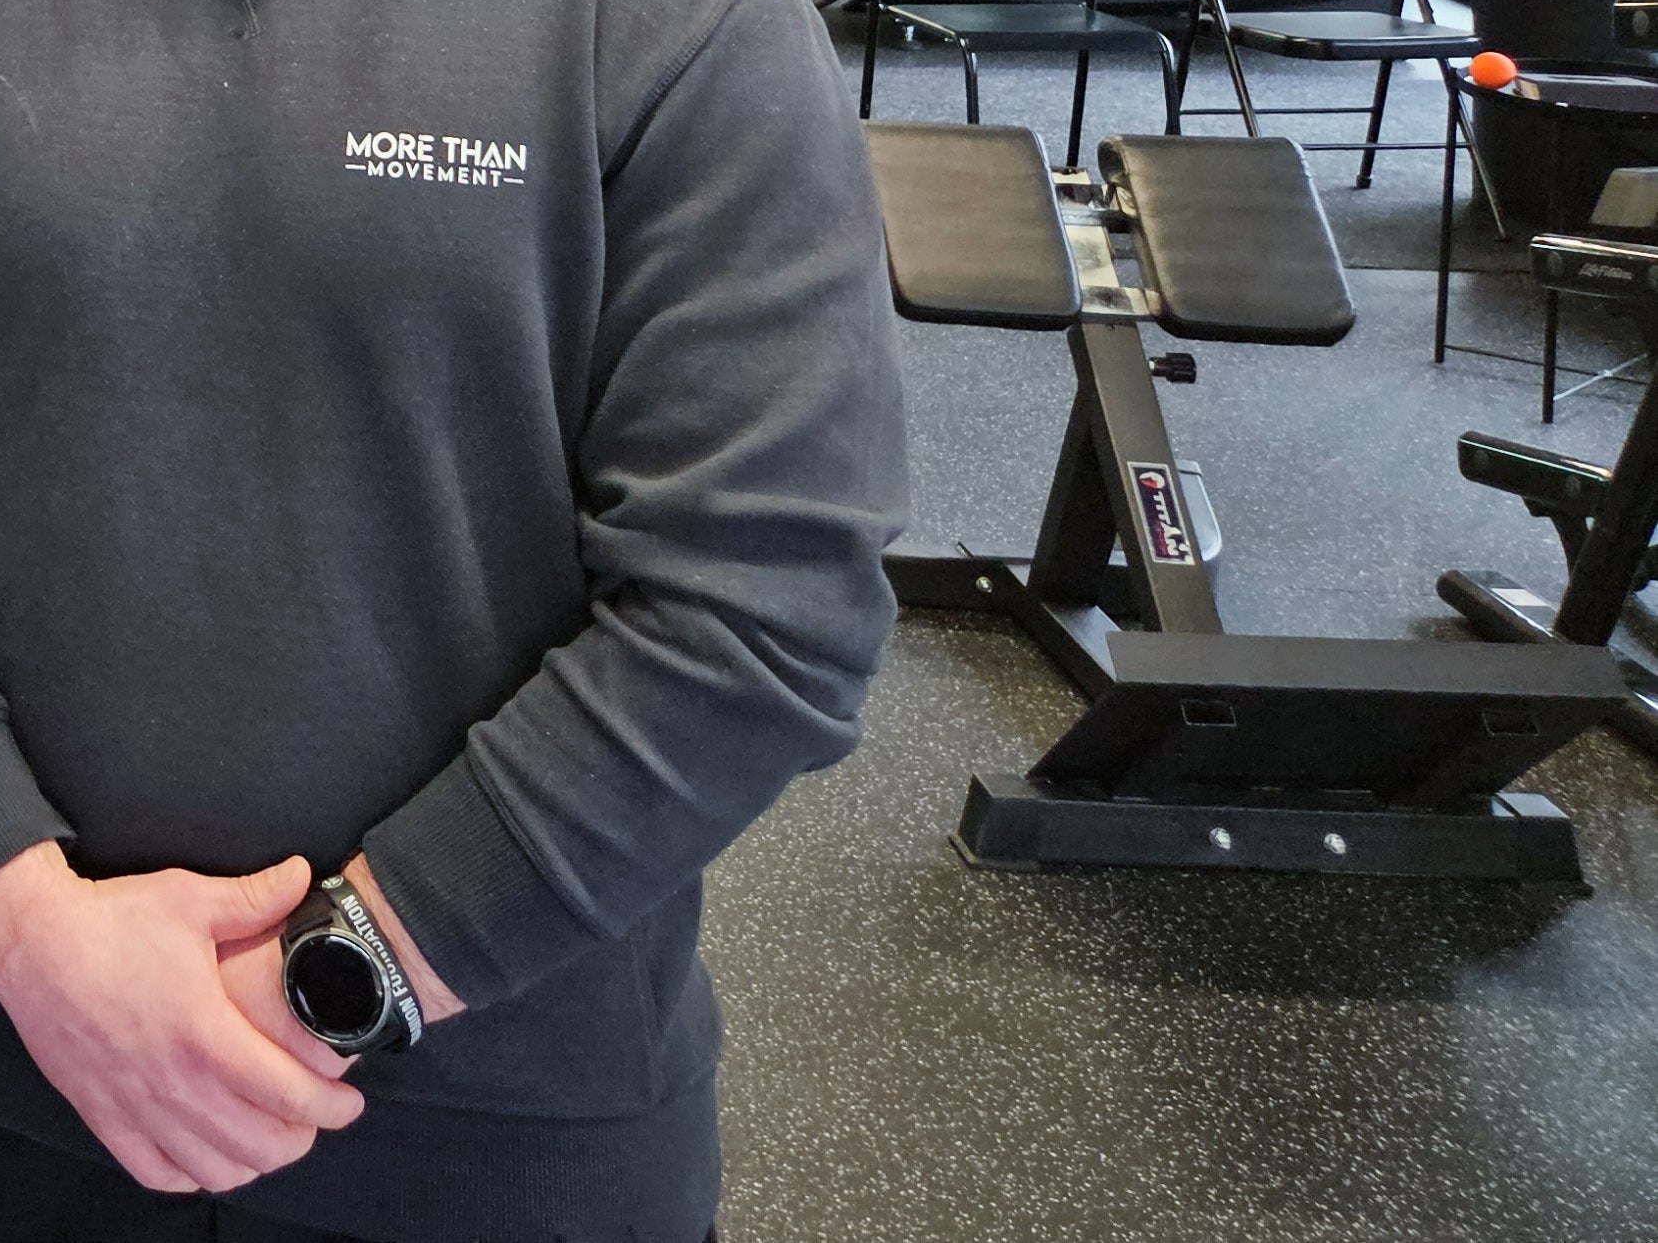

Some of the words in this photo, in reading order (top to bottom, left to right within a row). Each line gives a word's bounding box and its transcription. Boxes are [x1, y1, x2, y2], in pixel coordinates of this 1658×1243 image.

[345, 130, 436, 163] MORE
[442, 136, 528, 172] THAN
[367, 160, 502, 188] MOVEMENT
